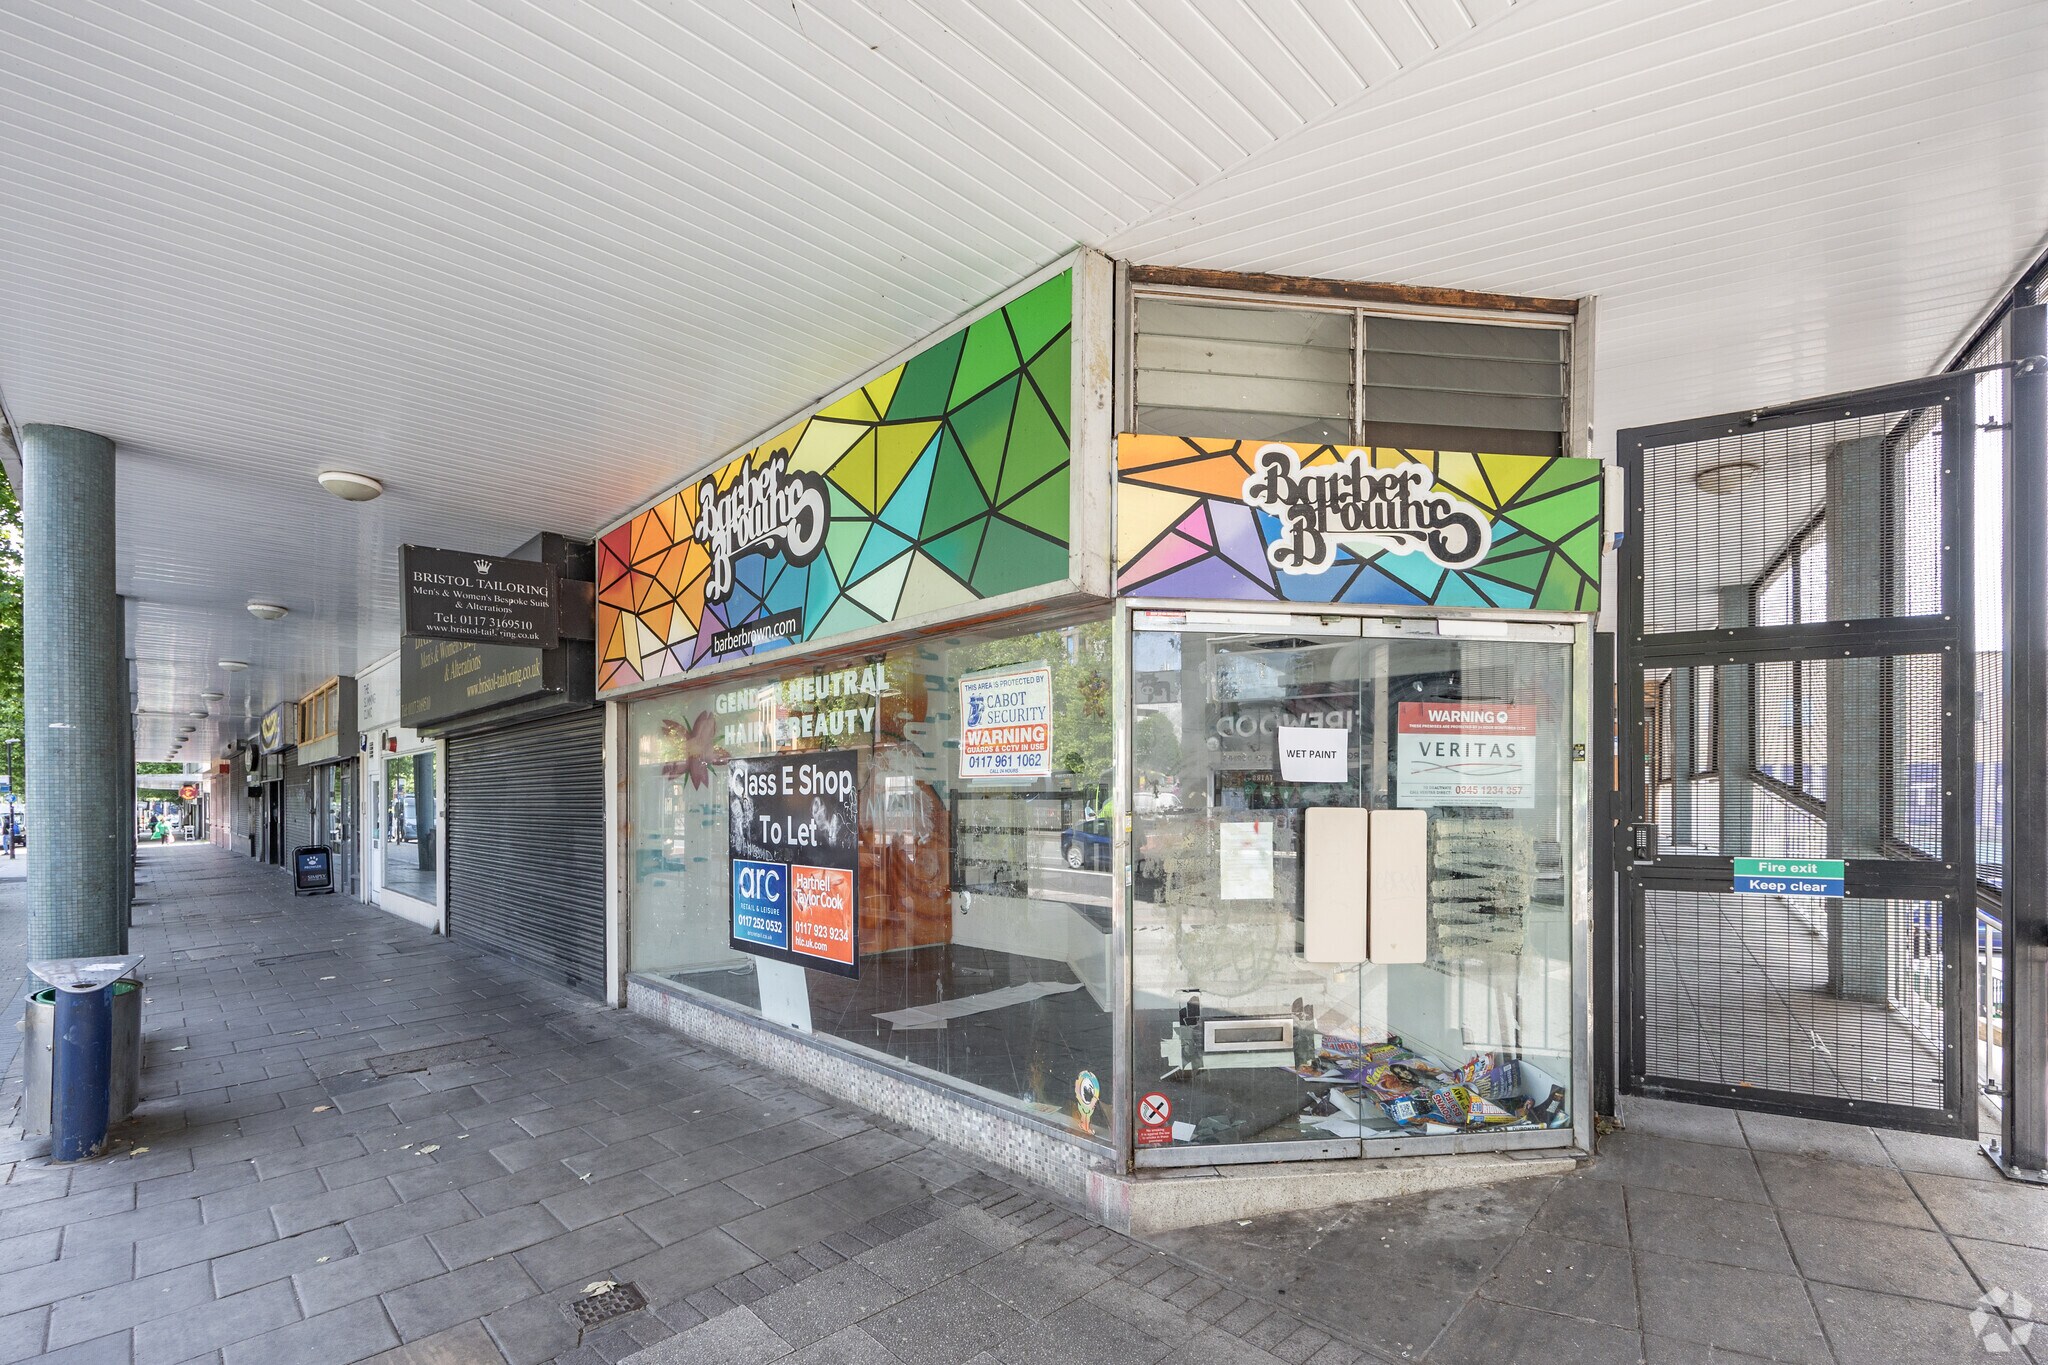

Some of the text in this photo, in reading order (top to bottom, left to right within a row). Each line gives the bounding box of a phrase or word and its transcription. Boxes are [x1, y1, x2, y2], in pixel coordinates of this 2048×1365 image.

[1250, 451, 1422, 506] Barber
[695, 457, 785, 542] Barber
[413, 571, 549, 597] BRISTOL TAILORING
[413, 585, 550, 608] Men's & Women's Bespoke Suits
[455, 601, 513, 613] & Alterations
[434, 612, 533, 630] Tel: 0117 3169510
[426, 624, 540, 640] www.bristol-tailring.co.uk
[714, 617, 796, 653] barberbrown.com
[451, 653, 481, 680] Alterations
[790, 663, 890, 703] NEUTRAL
[978, 682, 992, 690] AREA
[1000, 676, 1034, 687] PROTECTED
[1036, 675, 1045, 683] BY
[987, 691, 1026, 709] CABOT
[788, 707, 875, 740] BEAUTY
[987, 706, 1046, 725] SECURITY
[1428, 709, 1495, 723] WARNING
[967, 726, 1045, 746] WARNING
[967, 745, 993, 754] GUARDS
[1001, 744, 1020, 752] CCTV
[1021, 743, 1029, 751] IN
[1030, 743, 1045, 751] USE
[1286, 749, 1307, 759] WET
[1309, 750, 1337, 759] PAINT
[1419, 742, 1516, 759] VERITAS
[969, 753, 1042, 769] 0117 961 1062
[732, 764, 852, 803] Class E Shop
[1455, 785, 1523, 795] 0345 1234 357
[760, 815, 818, 847] To Let
[1758, 862, 1818, 874] Fire exit
[739, 866, 780, 902] arc
[796, 873, 830, 892] Hartnell
[1749, 879, 1828, 893] Keep clear
[740, 902, 755, 911] RETAIL
[761, 906, 780, 916] LEISURE
[738, 914, 783, 934] 0117 252 0532
[796, 921, 849, 942] 0117 923 9234
[1452, 1087, 1466, 1103] MAY
[1433, 1094, 1453, 1120] DOWNS
